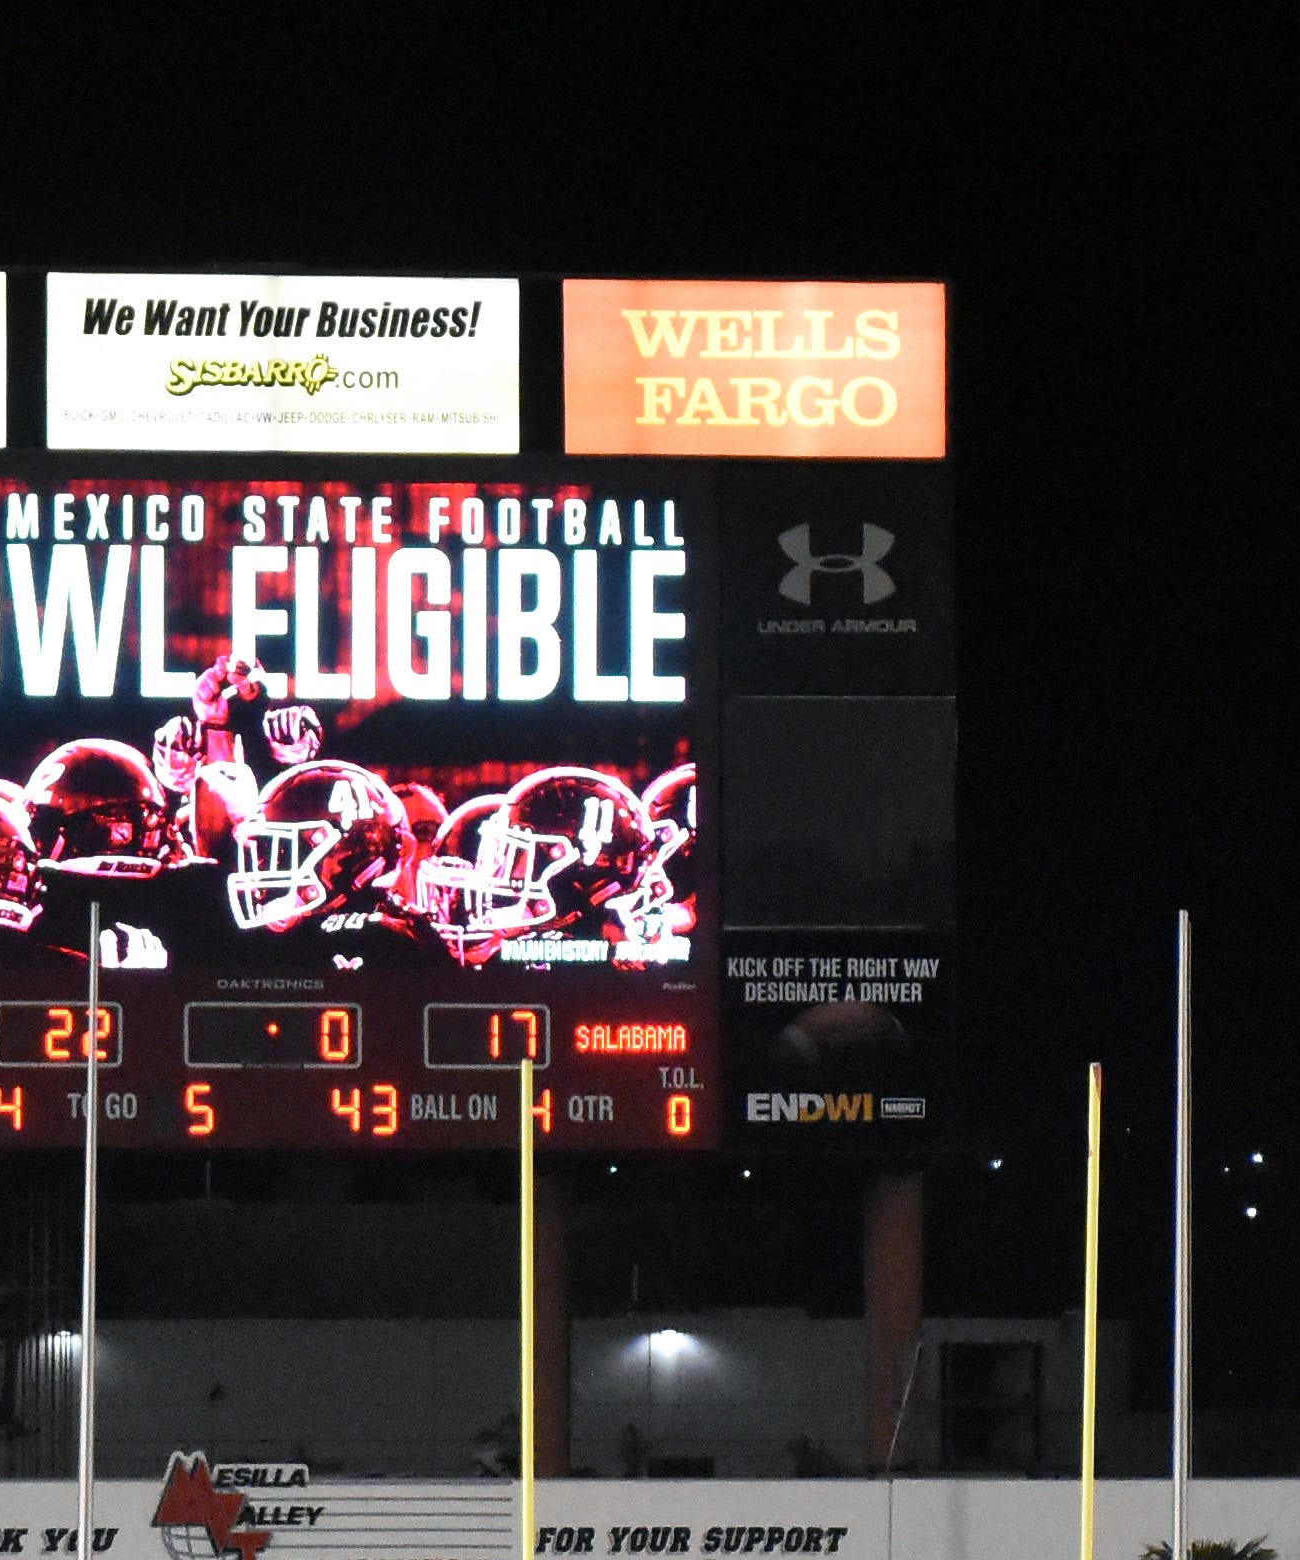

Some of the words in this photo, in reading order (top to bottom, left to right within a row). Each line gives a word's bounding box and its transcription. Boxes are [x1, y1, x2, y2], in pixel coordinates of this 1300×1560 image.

[83, 297, 137, 336] We
[143, 299, 233, 338] Want
[238, 300, 312, 338] Your
[316, 300, 483, 340] Business!
[622, 308, 901, 360] WELLS
[634, 376, 898, 428] FARGO
[6, 493, 204, 541] MEXICO
[243, 495, 393, 544] STATE
[428, 497, 685, 547] FOOTBALL
[231, 545, 686, 710] ELIGIBLE
[757, 619, 825, 634] UNDER
[831, 619, 917, 634] ARMOUR
[727, 957, 768, 979] KICK
[772, 957, 805, 979] OFF
[808, 957, 842, 979] THE
[847, 957, 898, 979] RIGHT
[902, 957, 940, 980] WAY
[744, 981, 839, 1003] DESIGNATE
[844, 981, 856, 1003] A
[860, 981, 923, 1003] DRIVER
[320, 1010, 349, 1060] 0
[488, 1011, 537, 1059] 17
[574, 1025, 687, 1052] SALABAMA
[658, 1066, 704, 1090] T.O.L.
[105, 1094, 138, 1120] GO
[185, 1084, 214, 1135] 5
[331, 1084, 397, 1135] 43
[411, 1094, 454, 1121] BALL
[460, 1094, 497, 1121] ON
[568, 1096, 614, 1122] QTR
[667, 1094, 690, 1135] 0
[746, 1092, 875, 1123] ENDWI
[537, 1526, 596, 1554] FOR
[609, 1526, 691, 1554] YOUR
[703, 1526, 848, 1554] SUPPORT
